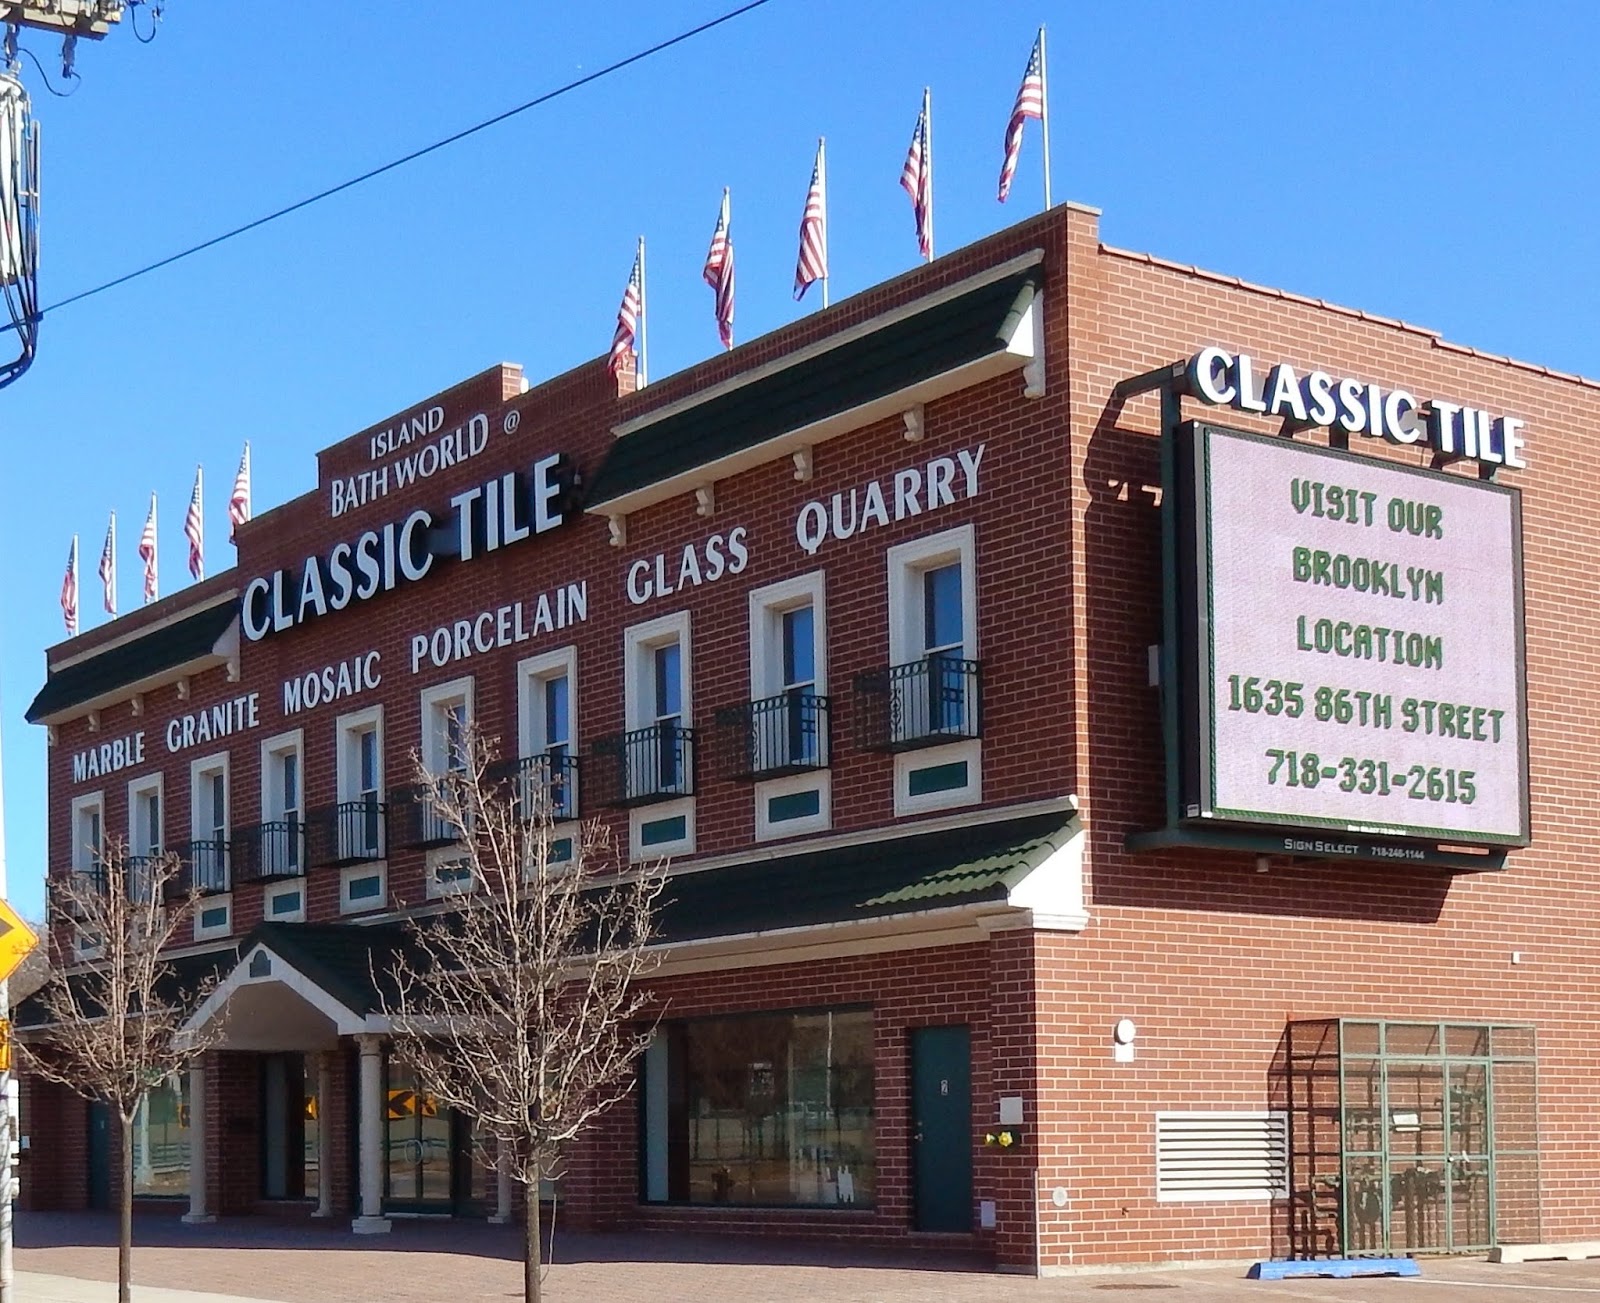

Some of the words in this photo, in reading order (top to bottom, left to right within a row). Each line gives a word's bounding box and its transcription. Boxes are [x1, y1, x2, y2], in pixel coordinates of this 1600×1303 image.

[369, 405, 445, 460] ISLAND
[1196, 346, 1421, 444] CLASSIC
[1430, 398, 1527, 469] TILE
[330, 465, 389, 518] BATH
[393, 412, 489, 490] WORLD
[503, 409, 521, 435] @
[796, 443, 986, 556] QUARRY
[1290, 476, 1377, 528] VISIT
[1386, 495, 1443, 540] OUR
[241, 509, 434, 642] CLASSIC
[450, 453, 563, 562] TILE
[626, 526, 749, 605] GLASS
[1292, 545, 1443, 605] BROOKLYN
[411, 580, 588, 674] PORCELAIN
[1296, 614, 1443, 671] LOCATION
[283, 650, 382, 716] MOSAIC
[1227, 674, 1304, 718] 1635
[1313, 685, 1392, 729] 86TH
[1401, 697, 1505, 744] STREET
[166, 691, 260, 754] GRANITE
[73, 731, 145, 783] MARBLE
[1265, 748, 1477, 805] 718-331-2615
[1284, 837, 1313, 851] SIGN
[1314, 840, 1359, 855] SELECT
